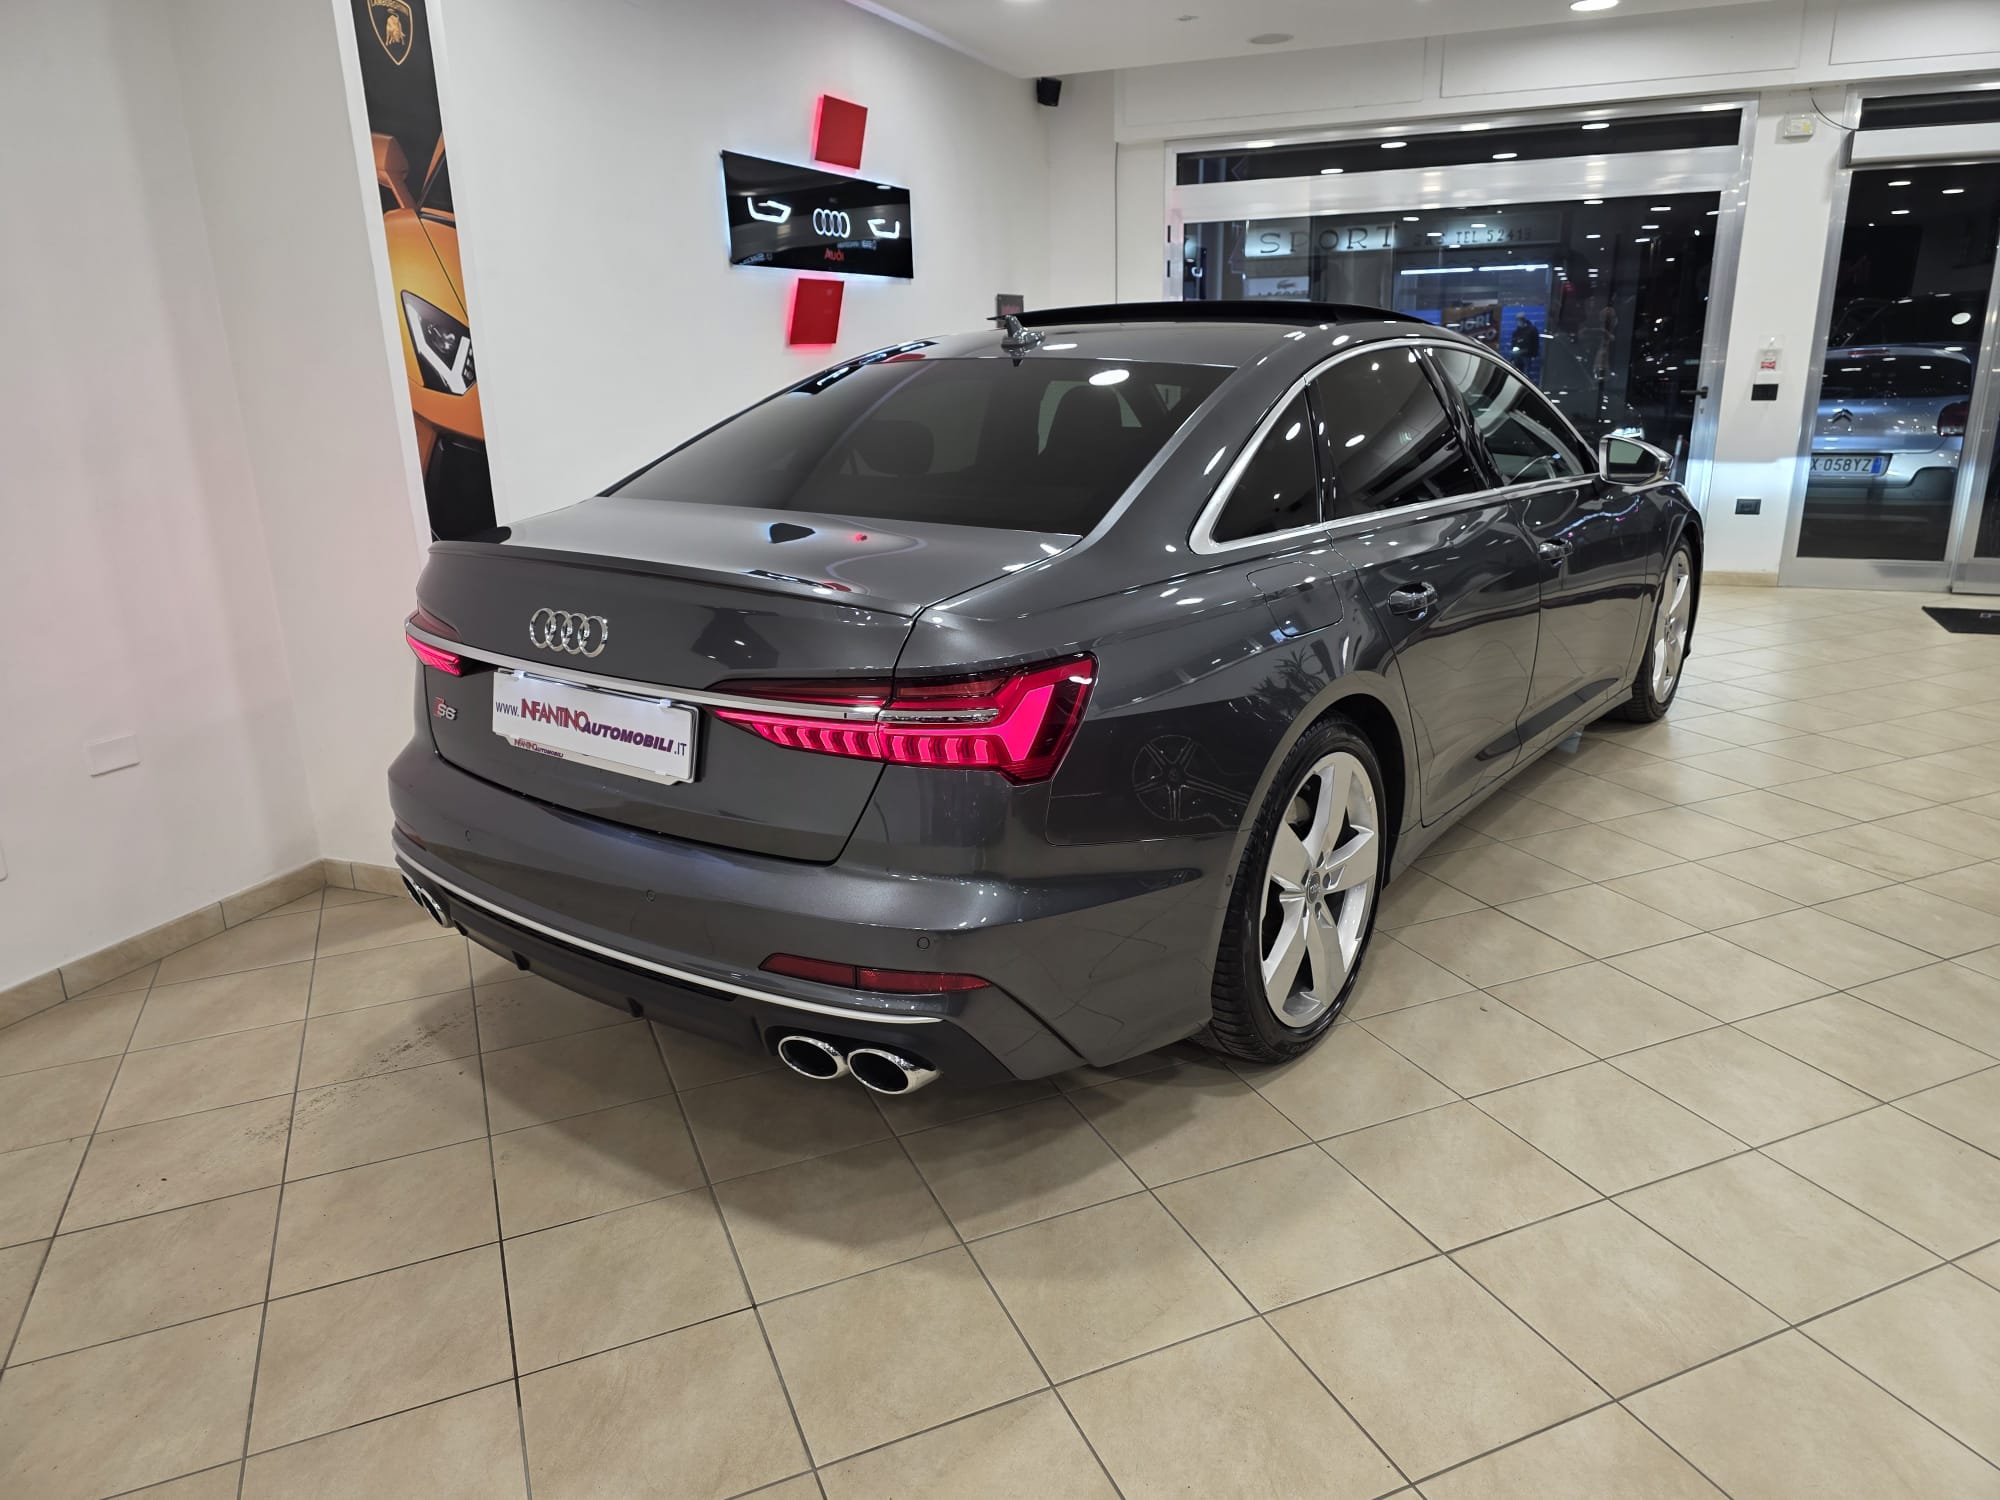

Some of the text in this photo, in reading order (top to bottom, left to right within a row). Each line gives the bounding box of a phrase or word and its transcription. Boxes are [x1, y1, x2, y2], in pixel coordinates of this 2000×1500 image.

[1260, 226, 1398, 254] SPORT
[1456, 230, 1478, 245] TEL
[824, 248, 844, 261] Audi
[1823, 458, 1872, 472] 058YZ
[437, 703, 457, 720] S6
